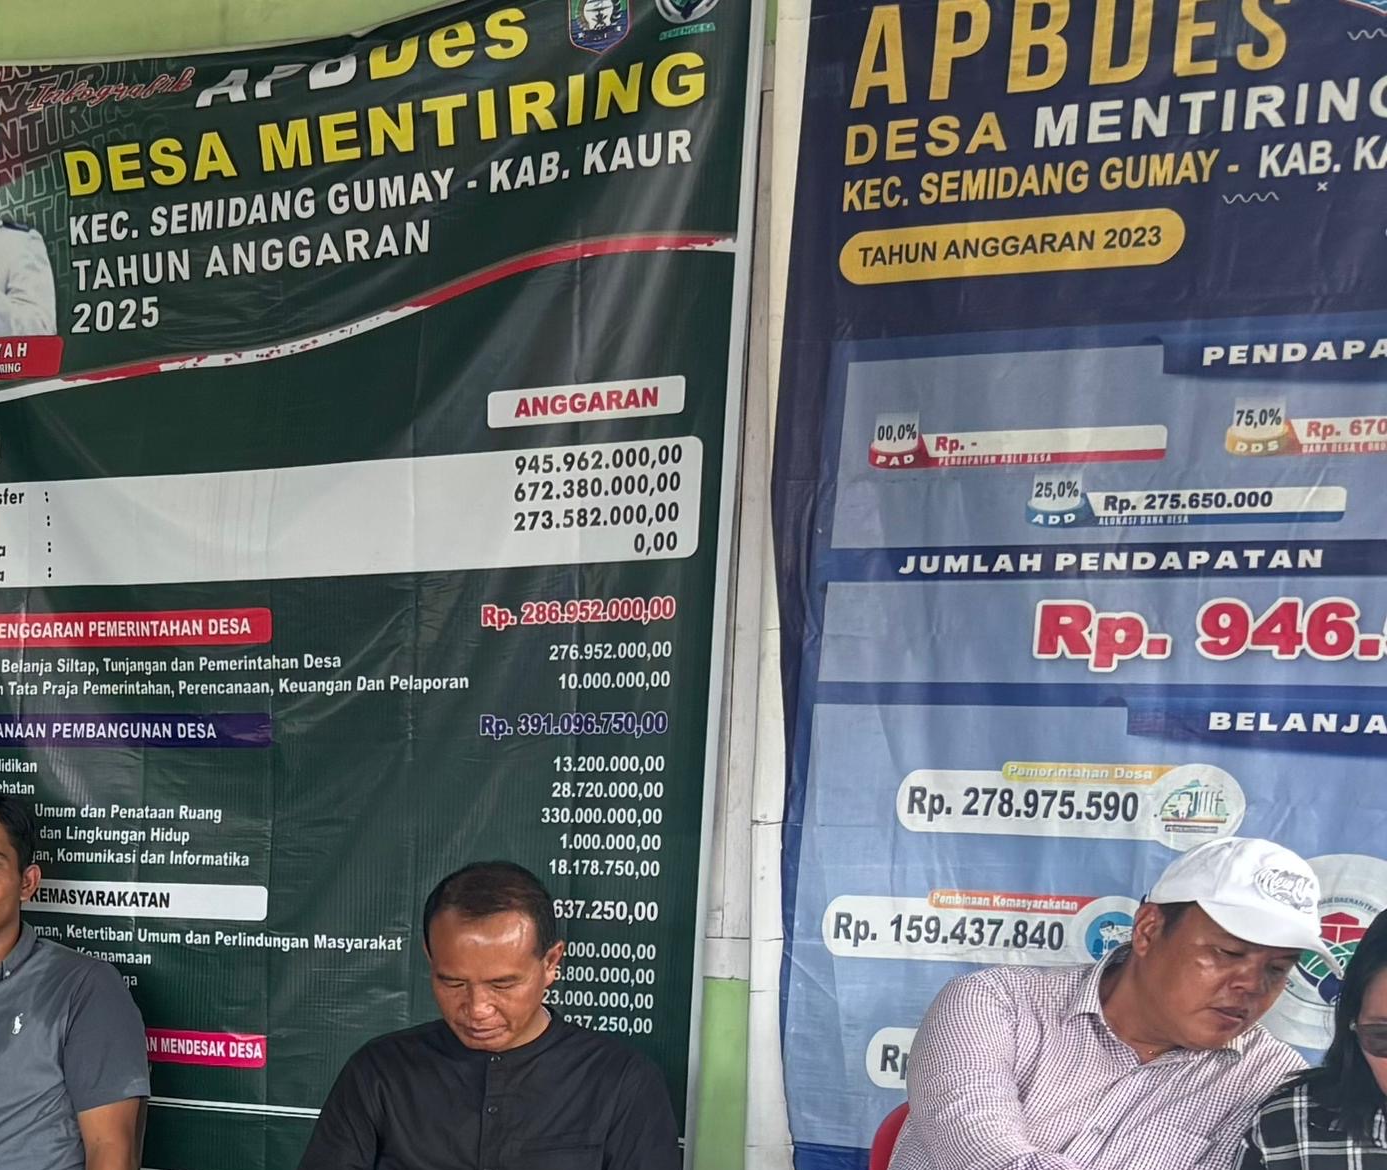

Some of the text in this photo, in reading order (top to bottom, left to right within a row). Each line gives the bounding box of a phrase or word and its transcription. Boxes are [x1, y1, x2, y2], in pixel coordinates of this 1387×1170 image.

[849, 0, 1290, 109] APBDES
[64, 131, 238, 197] DESA
[258, 51, 706, 172] MENTIRING
[844, 111, 1008, 166] DESA
[69, 129, 692, 246] KEC. SEMIDANG GUMAY KAB. KAUR
[842, 140, 1341, 213] KEC. SEMIDANG GUMAY KAB.
[73, 218, 430, 291] TAHUN ANGGARAN
[859, 225, 1163, 268] TAHUN ANGGARAN 2023
[70, 296, 160, 334] 2025
[514, 386, 659, 418] ANGGARAN
[1236, 408, 1282, 429] 75,0%
[877, 423, 917, 443] 00,0%
[1307, 421, 1341, 440] Rp.
[935, 436, 965, 454] Rp.
[514, 443, 683, 476] 945.962.000,00
[876, 454, 915, 467] PAD
[513, 471, 681, 503] 672.380.000,00
[1034, 480, 1079, 500] 25,0%
[1104, 491, 1273, 513] Rp. 275.650.000
[513, 501, 679, 532] 273.582.000,00
[1031, 513, 1076, 526] ADD
[634, 531, 678, 556] 0,00
[899, 548, 1324, 576] JUMLAH PENDAPATAN
[481, 596, 676, 631] Rp. 286.952.000,00
[88, 618, 203, 638] PEMERINTAHAN
[208, 617, 252, 635] DESA
[1032, 596, 1387, 673] Rp. 946.
[548, 641, 672, 661] 276.952.000,00
[1, 658, 52, 676] Belanja
[56, 658, 99, 675] Siltap,
[103, 657, 167, 675] Tunjangan
[171, 657, 194, 672] dan
[199, 655, 299, 672] Pemerintahan
[303, 653, 341, 669] Desa
[8, 681, 38, 695] Tata
[42, 681, 78, 698] Praja
[83, 680, 175, 698] Pemerintahan,
[178, 680, 274, 697] Perencanaan,
[279, 677, 352, 696] Keuangan
[357, 675, 384, 691] Dan
[389, 674, 469, 694] Pelaporan
[558, 671, 671, 690] 10.000.000,00
[52, 722, 172, 739] PEMBANGUNAN
[177, 723, 217, 739] DESA
[480, 712, 668, 740] Rp. 391.096.750,00
[1208, 711, 1387, 735] BELANJA
[553, 756, 665, 775] 13.200.000,00
[551, 781, 664, 801] 28.720.000,00
[35, 803, 76, 818] Umum
[81, 804, 106, 818] dan
[111, 804, 174, 819] Penataan
[179, 805, 223, 824] Ruang
[906, 786, 1139, 822] Rp. 278.975.590
[540, 807, 663, 827] 330.000.000,00
[39, 826, 190, 845] dan Lingkungan Hidup
[560, 833, 662, 853] 1.000.000,00
[57, 848, 250, 867] Komunikasi dan Informatika
[548, 859, 661, 879] 18.178.750,00
[30, 887, 170, 909] KEMASYARAKATAN
[66, 924, 133, 942] Ketertiban
[137, 928, 181, 944] Umum
[185, 931, 210, 945] dan
[215, 931, 309, 952] Perlindungan
[314, 934, 402, 953] Masyarakat
[833, 911, 1064, 951] Rp. 159.437.840
[161, 1038, 263, 1058] MENDESAK DESA
